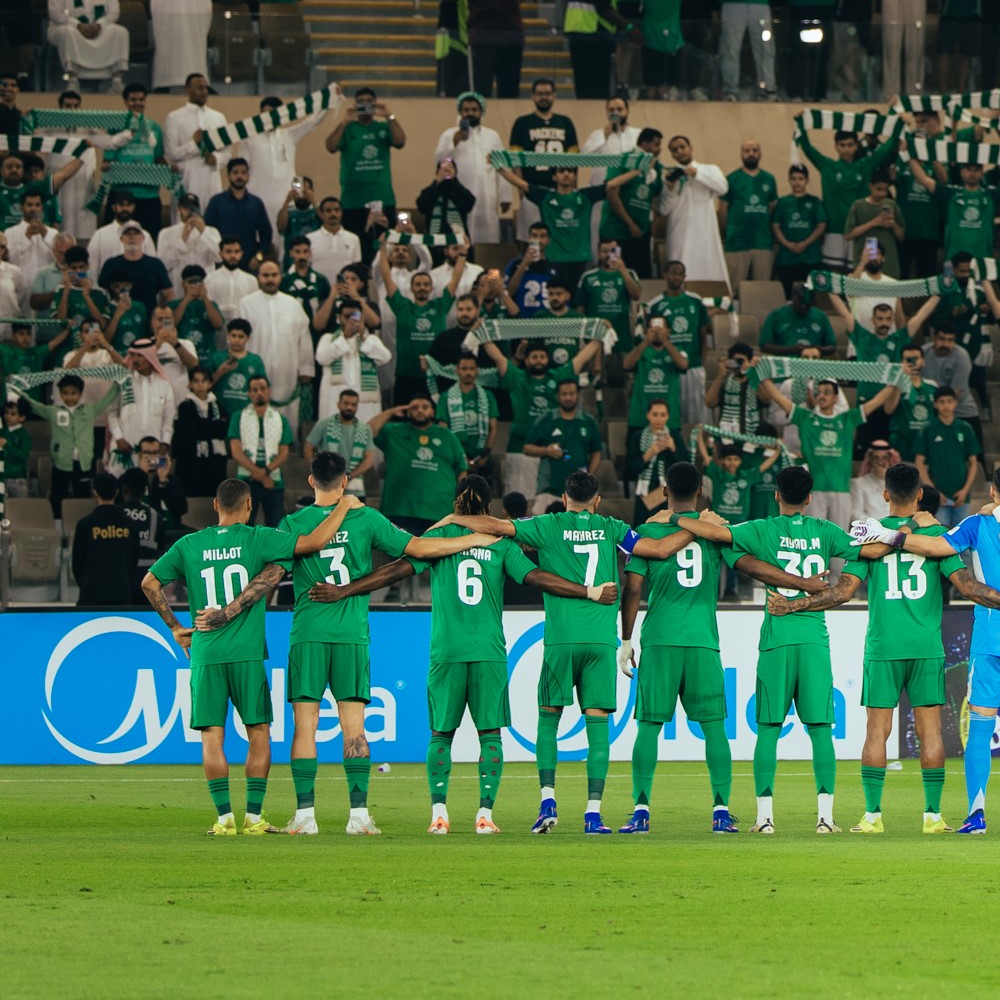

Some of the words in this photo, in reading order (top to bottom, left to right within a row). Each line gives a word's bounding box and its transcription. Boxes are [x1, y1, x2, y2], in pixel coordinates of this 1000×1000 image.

[92, 526, 129, 539] Police
[203, 547, 242, 561] MILLOT
[563, 530, 606, 541] MAHREZ
[320, 547, 350, 587] 3
[457, 559, 483, 605] 6
[573, 543, 599, 587] 7
[676, 541, 703, 588] 9
[883, 552, 928, 600] 13
[200, 564, 249, 611] 10
